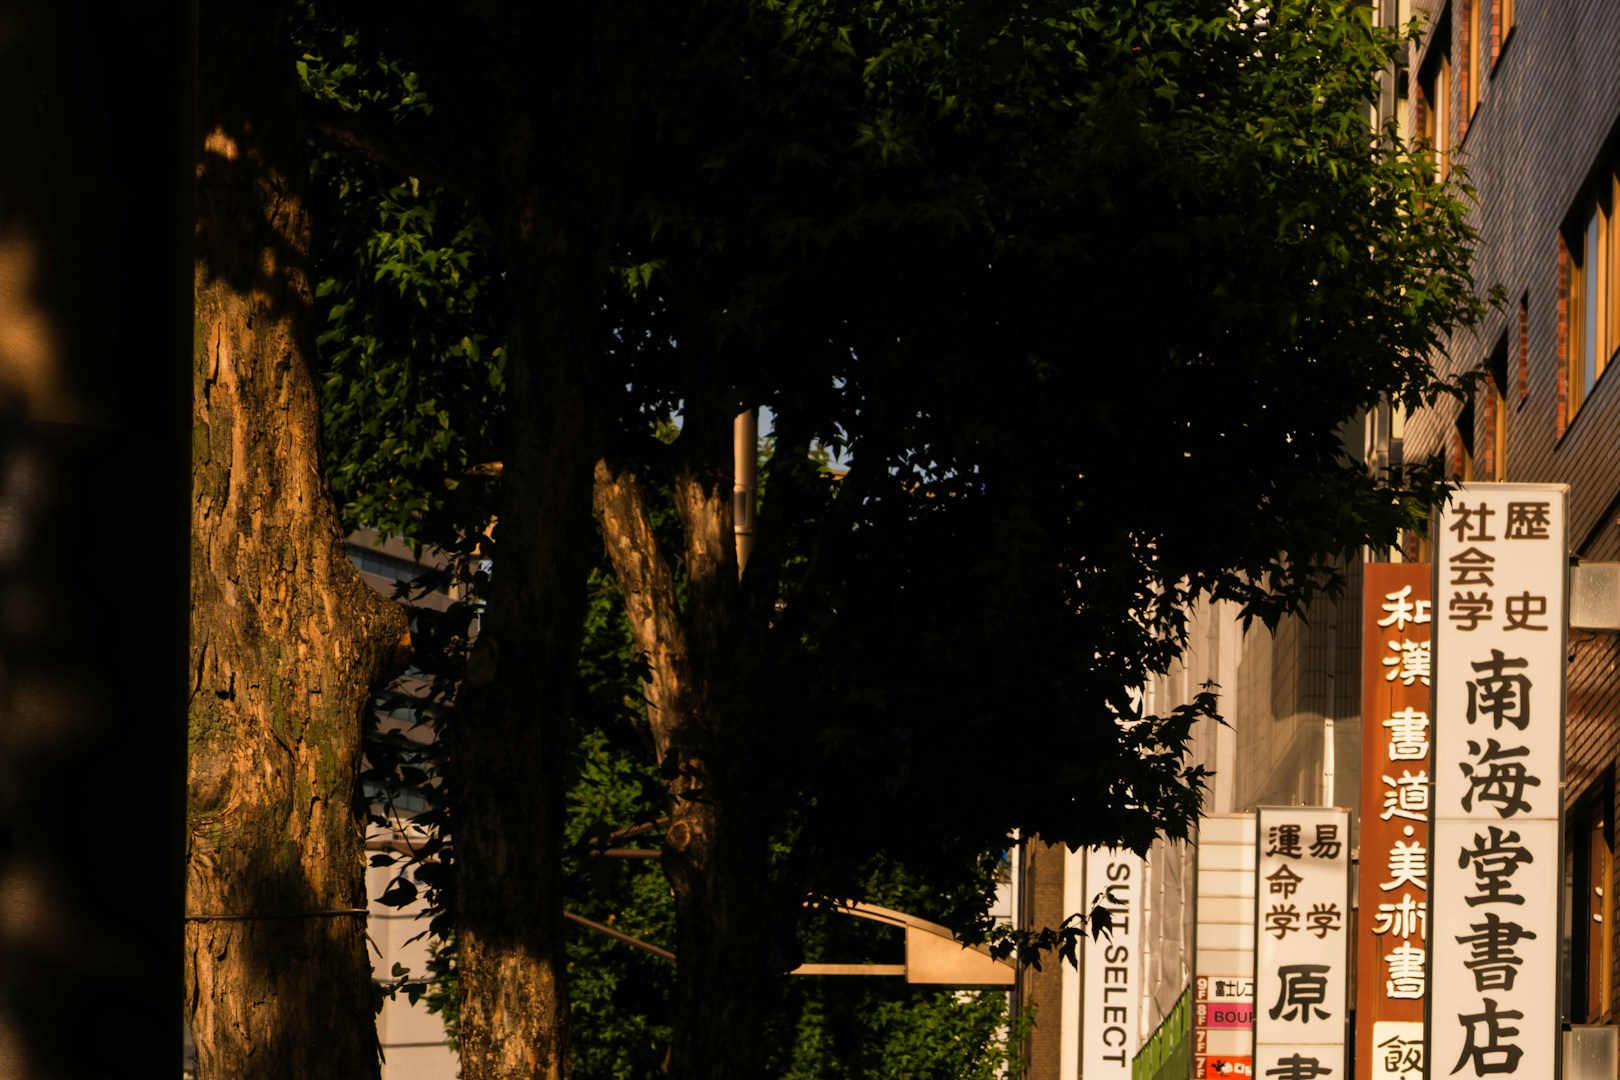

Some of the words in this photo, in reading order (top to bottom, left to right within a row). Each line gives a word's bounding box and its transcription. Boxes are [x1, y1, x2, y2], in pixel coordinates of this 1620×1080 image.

[1449, 502, 1496, 631] 社会学
[1503, 502, 1550, 631] 歴史
[1106, 862, 1130, 935] SUIT
[1265, 825, 1304, 940] 運命学
[1306, 825, 1342, 940] 易学
[1449, 649, 1541, 1078] 南海堂書店
[1102, 945, 1128, 1068] SELECT
[1195, 1031, 1205, 1052] 7F
[1196, 1003, 1207, 1026] 8F
[1197, 978, 1207, 1000] 9F
[1195, 1057, 1205, 1079] 7F
